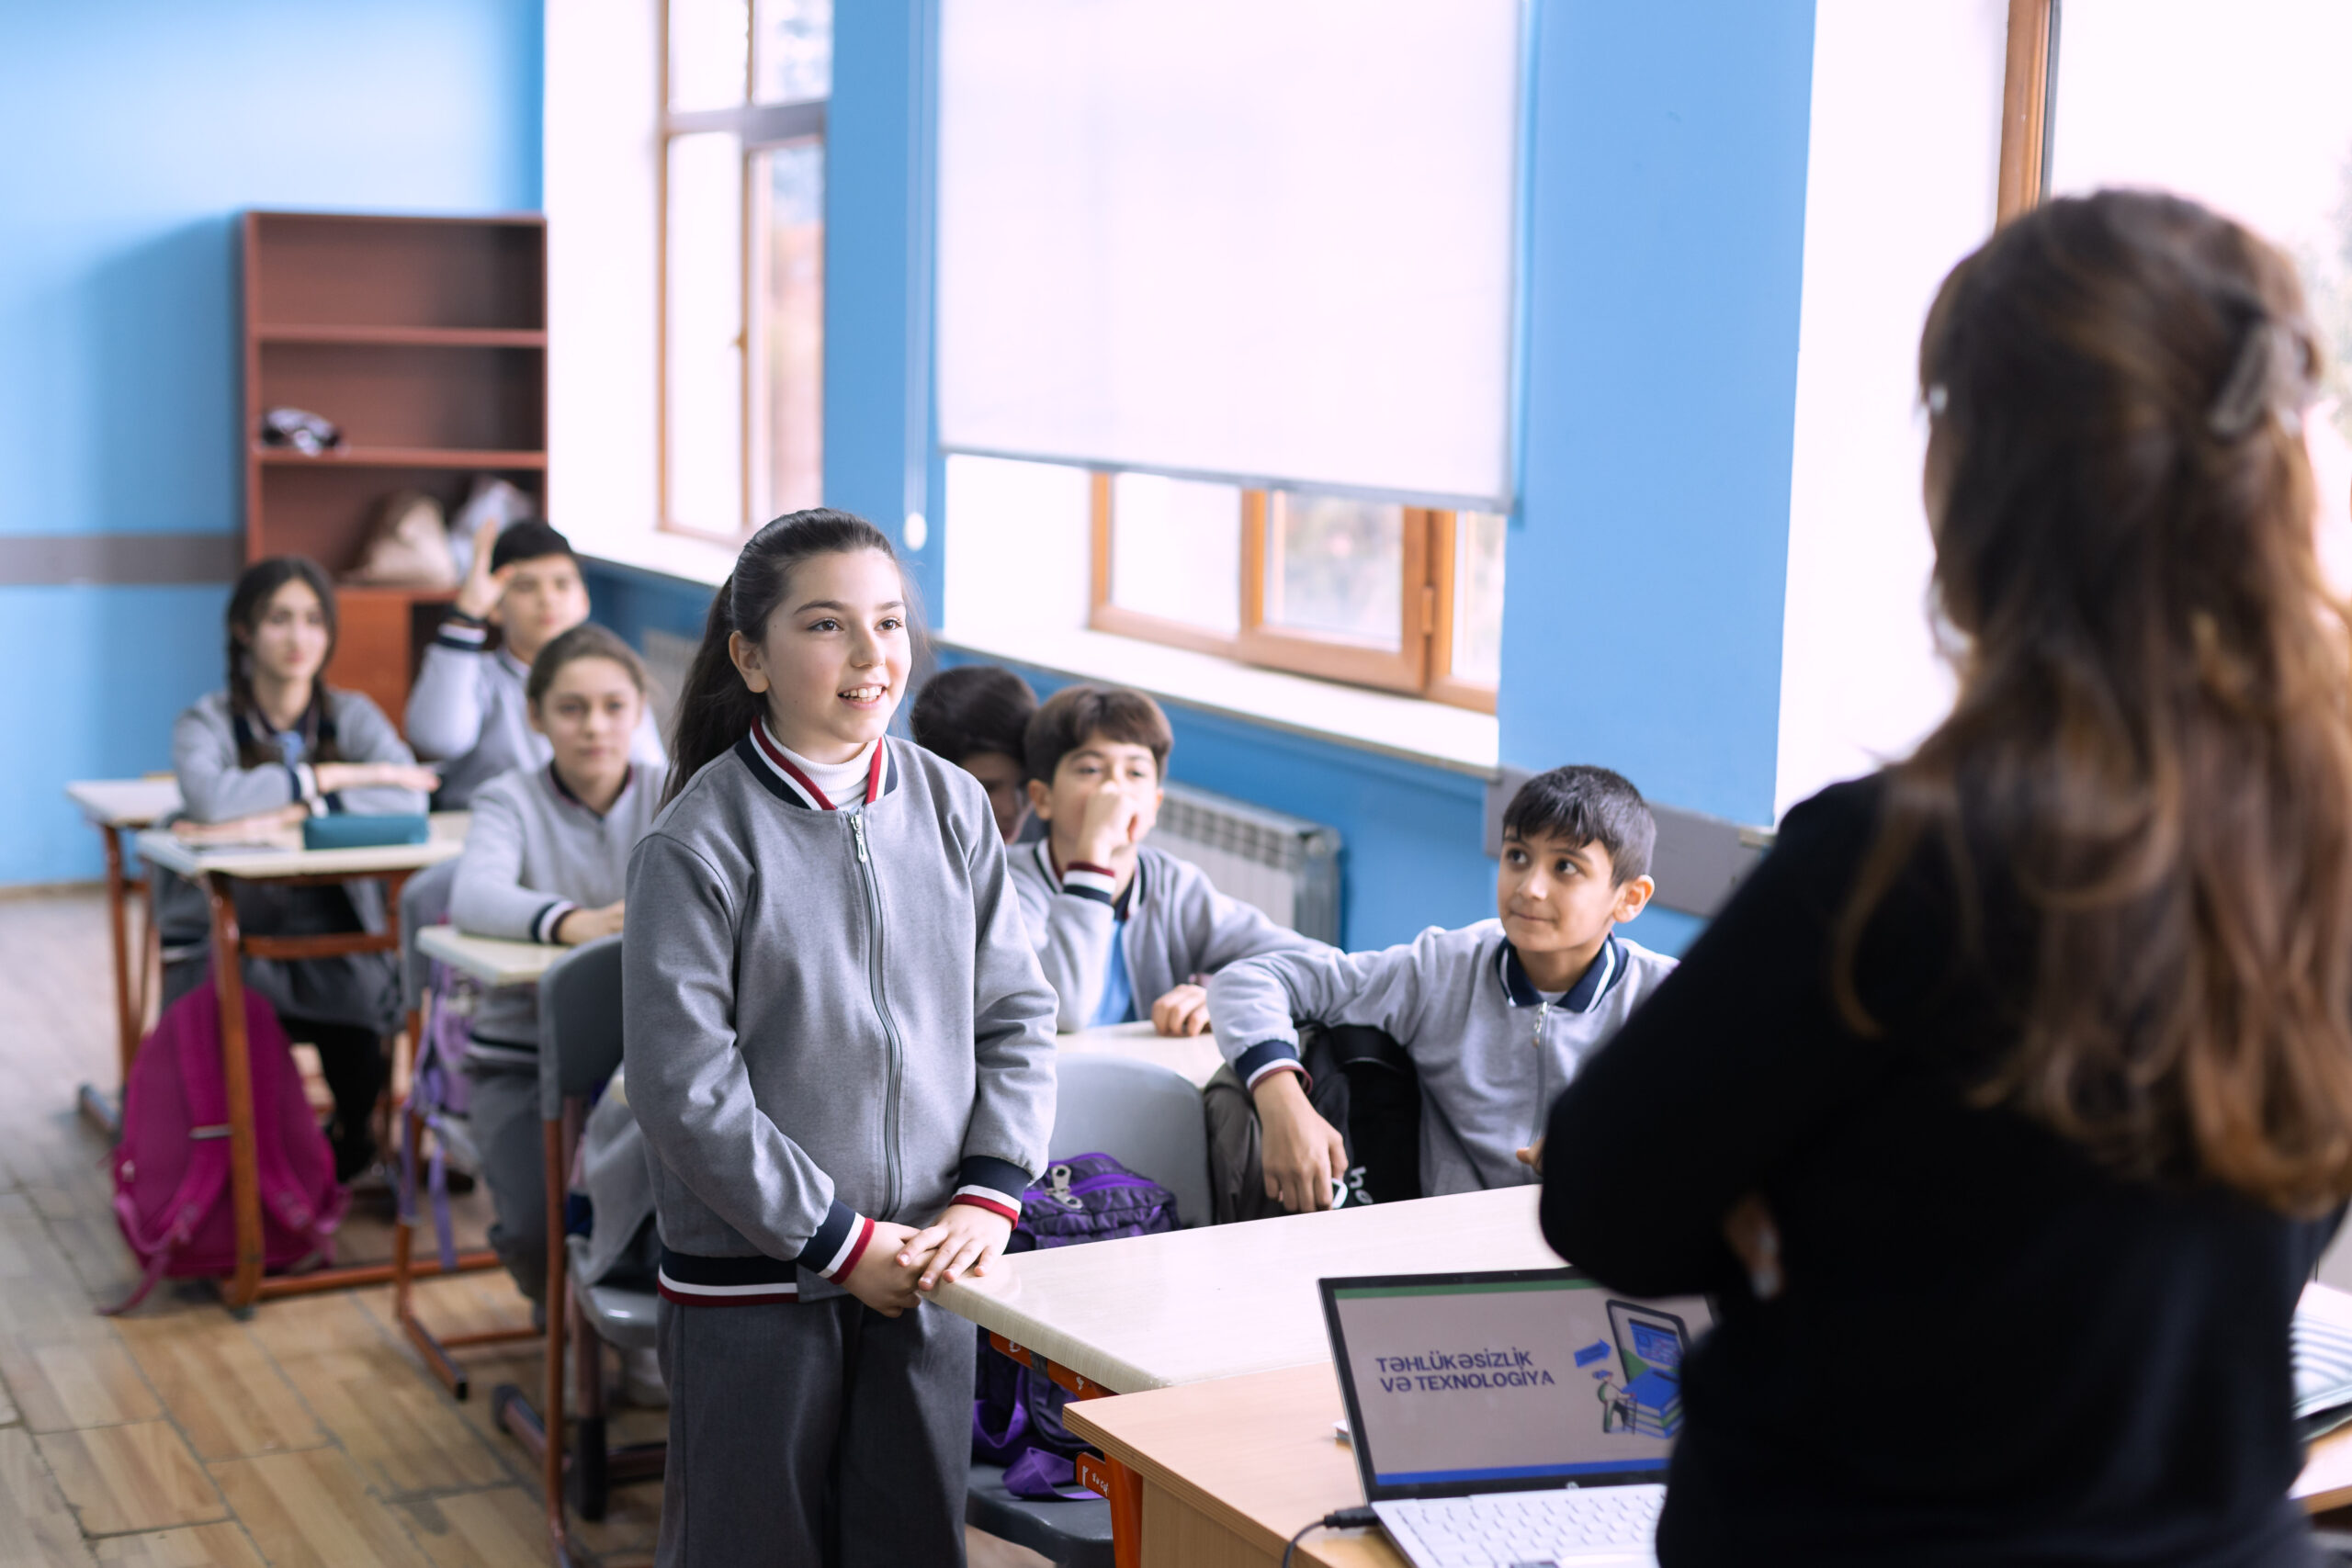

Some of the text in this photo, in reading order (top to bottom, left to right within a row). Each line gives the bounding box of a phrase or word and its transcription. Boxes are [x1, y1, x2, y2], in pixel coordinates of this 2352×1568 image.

[1375, 1347, 1533, 1373] TƏHLÜKƏSİZLİK
[1380, 1367, 1555, 1393] VƏ TEXNOLOGİYA
